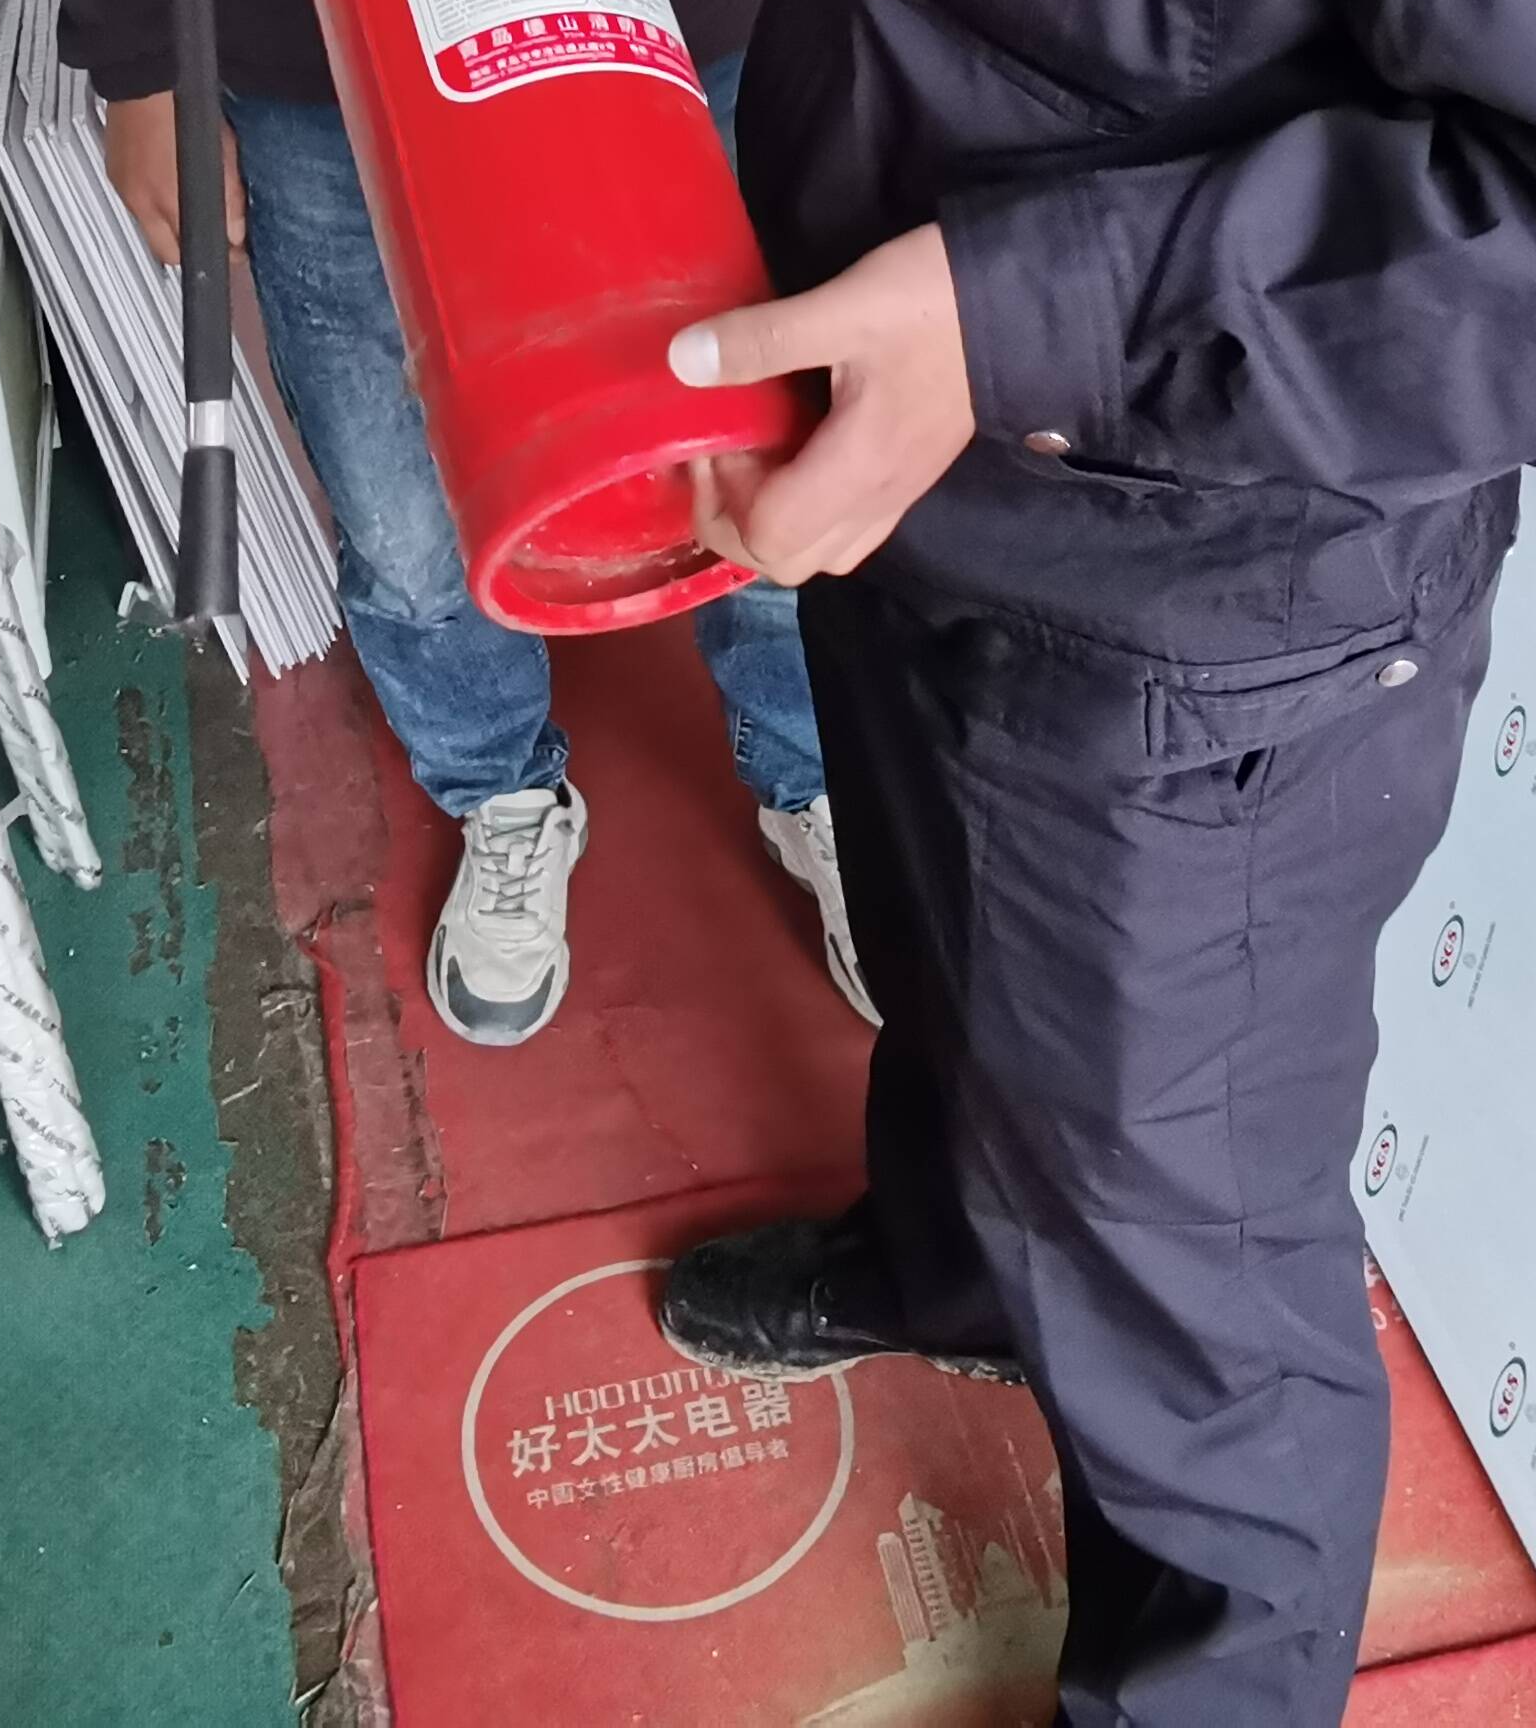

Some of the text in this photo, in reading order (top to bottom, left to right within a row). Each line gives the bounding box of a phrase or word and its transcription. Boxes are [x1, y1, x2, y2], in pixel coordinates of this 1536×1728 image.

[1503, 718, 1520, 760] SGS
[1440, 928, 1458, 970] SGS
[1371, 1139, 1391, 1180] SGS
[1498, 1374, 1519, 1422] SGS
[506, 1381, 793, 1478] 好太太电器
